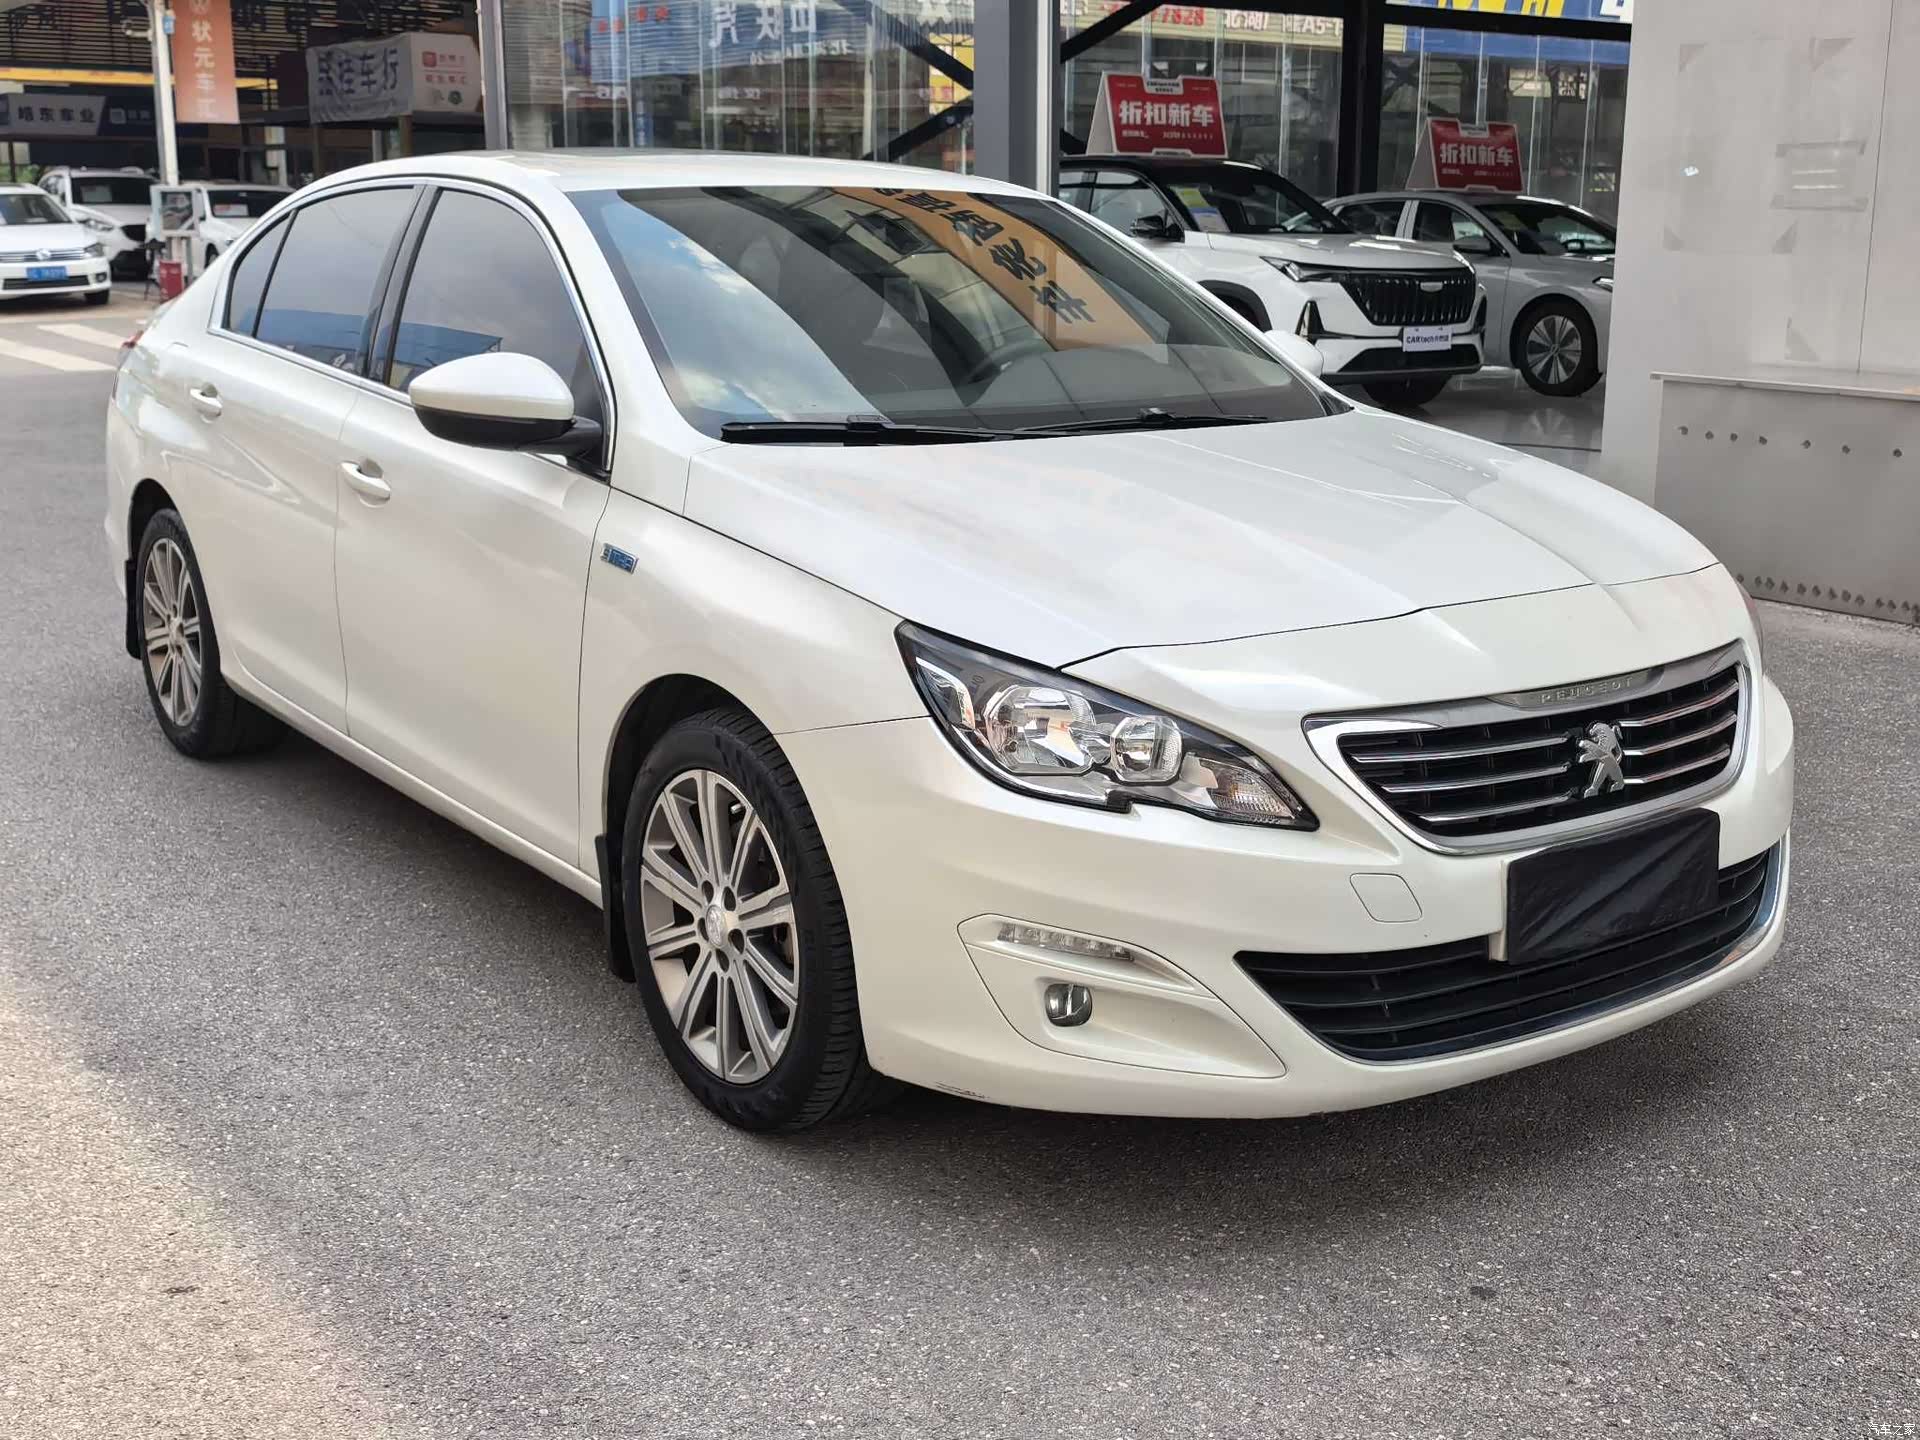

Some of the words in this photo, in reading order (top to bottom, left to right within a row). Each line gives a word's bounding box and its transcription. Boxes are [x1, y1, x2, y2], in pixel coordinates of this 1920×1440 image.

[1119, 100, 1214, 127] 折扣新车
[1440, 142, 1514, 167] 折扣新车
[1538, 677, 1633, 704] PEUGEOT
